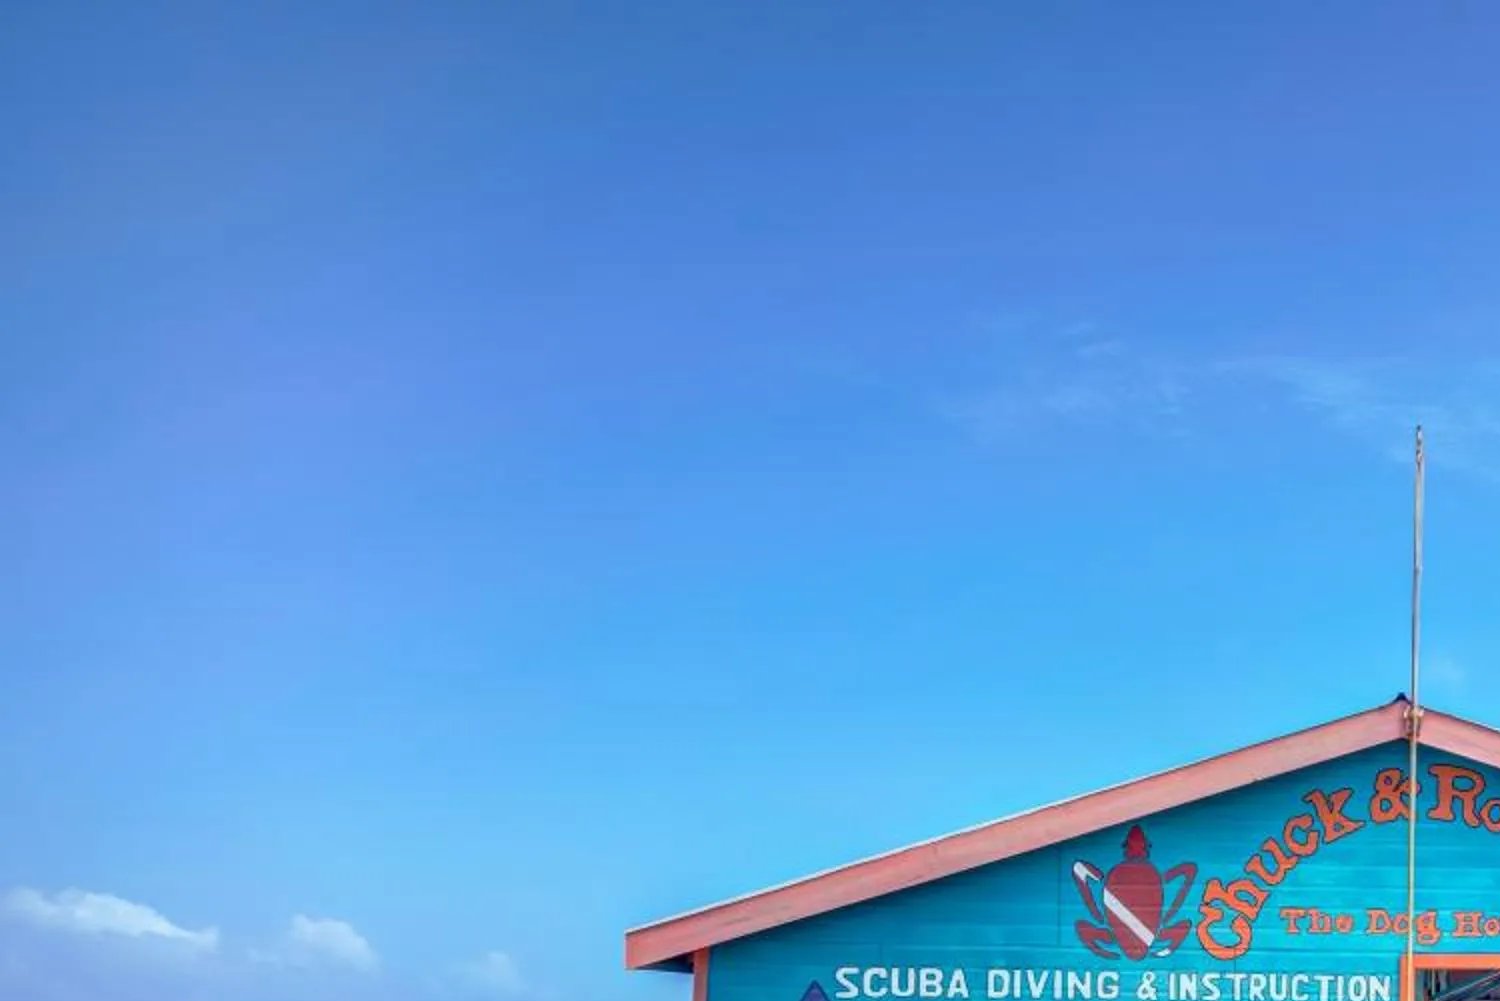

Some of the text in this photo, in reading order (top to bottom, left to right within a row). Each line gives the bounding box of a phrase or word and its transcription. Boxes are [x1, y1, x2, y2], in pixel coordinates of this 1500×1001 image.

[1196, 787, 1368, 960] Chuck
[1369, 768, 1422, 824] &
[1280, 907, 1353, 935] The
[1366, 907, 1441, 945] Dog
[834, 966, 969, 1000] SCUBA
[986, 968, 1120, 1000] DIVING
